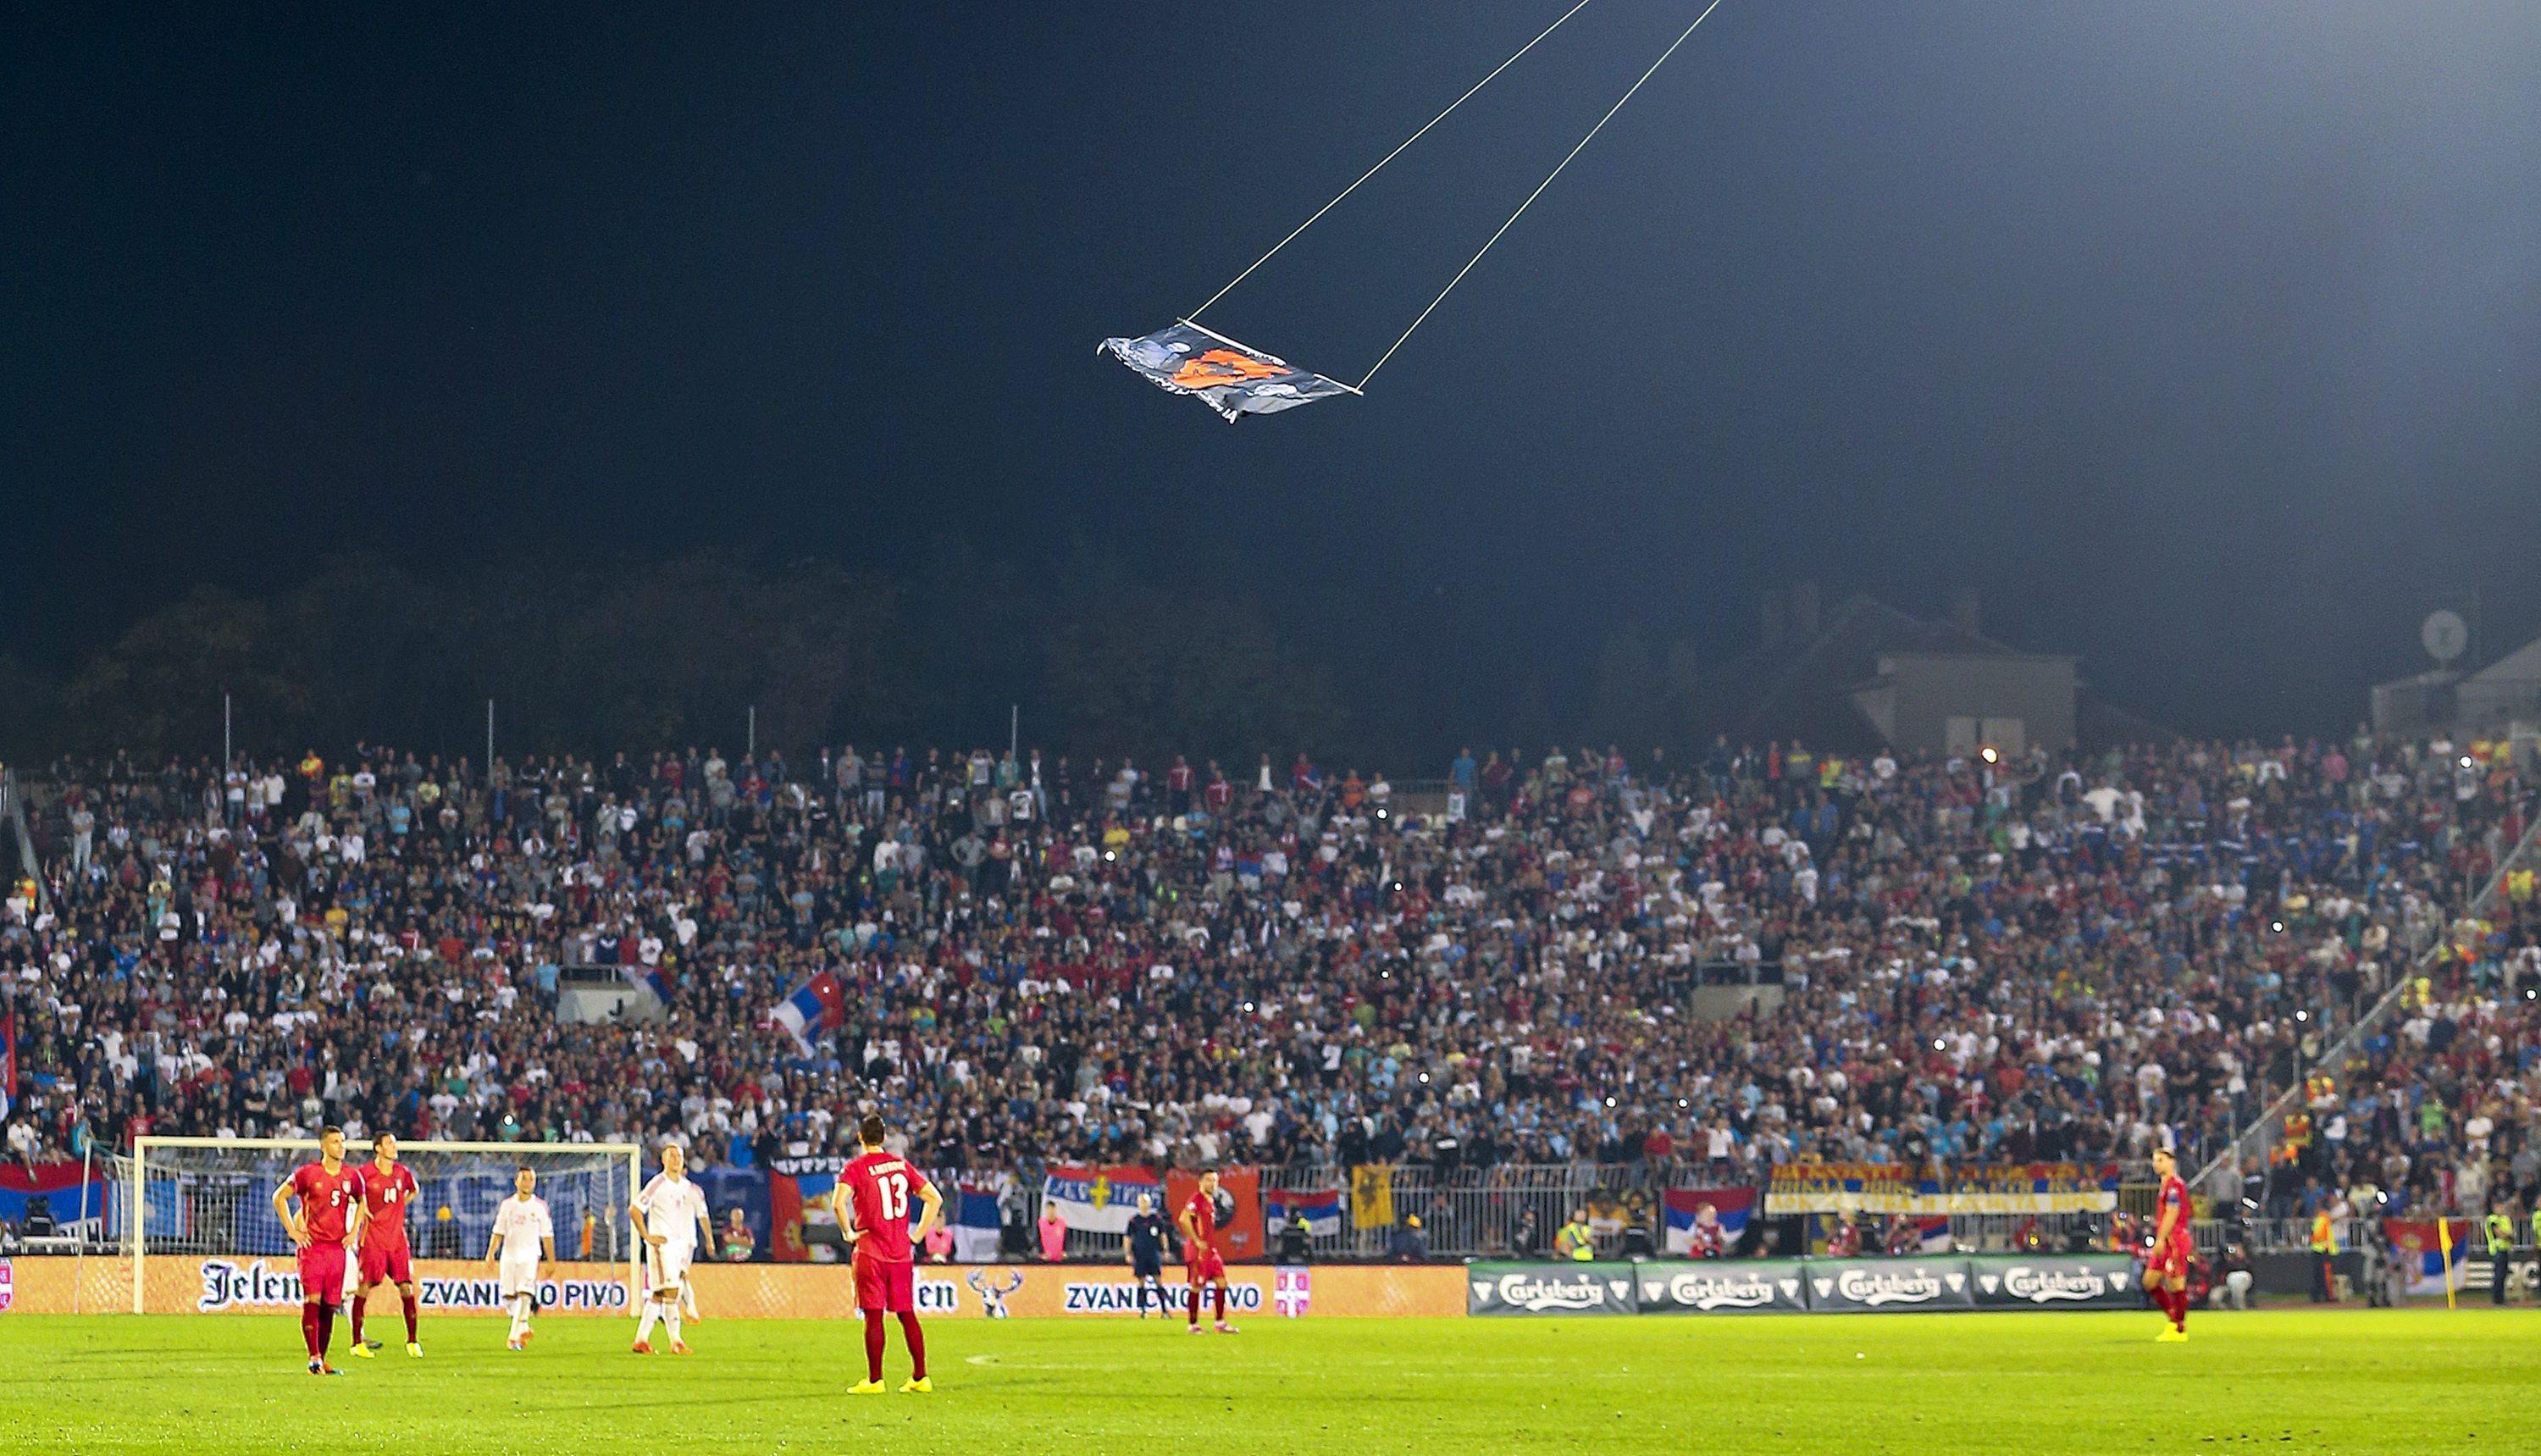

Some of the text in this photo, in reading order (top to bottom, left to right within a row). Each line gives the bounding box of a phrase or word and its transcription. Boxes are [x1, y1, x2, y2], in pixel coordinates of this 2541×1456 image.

[331, 1190, 340, 1207] 5
[877, 1173, 908, 1220] 13
[202, 1260, 302, 1304] Jelen
[421, 1282, 626, 1307] ZVANIO PIVO
[918, 1284, 955, 1309] en
[1204, 1287, 1259, 1309] PVO
[1498, 1274, 1604, 1312] Carlsberg
[1669, 1273, 1775, 1311] Carlsberg
[1838, 1267, 1942, 1306] Carlsberg
[2004, 1265, 2106, 1304] Carlsberg
